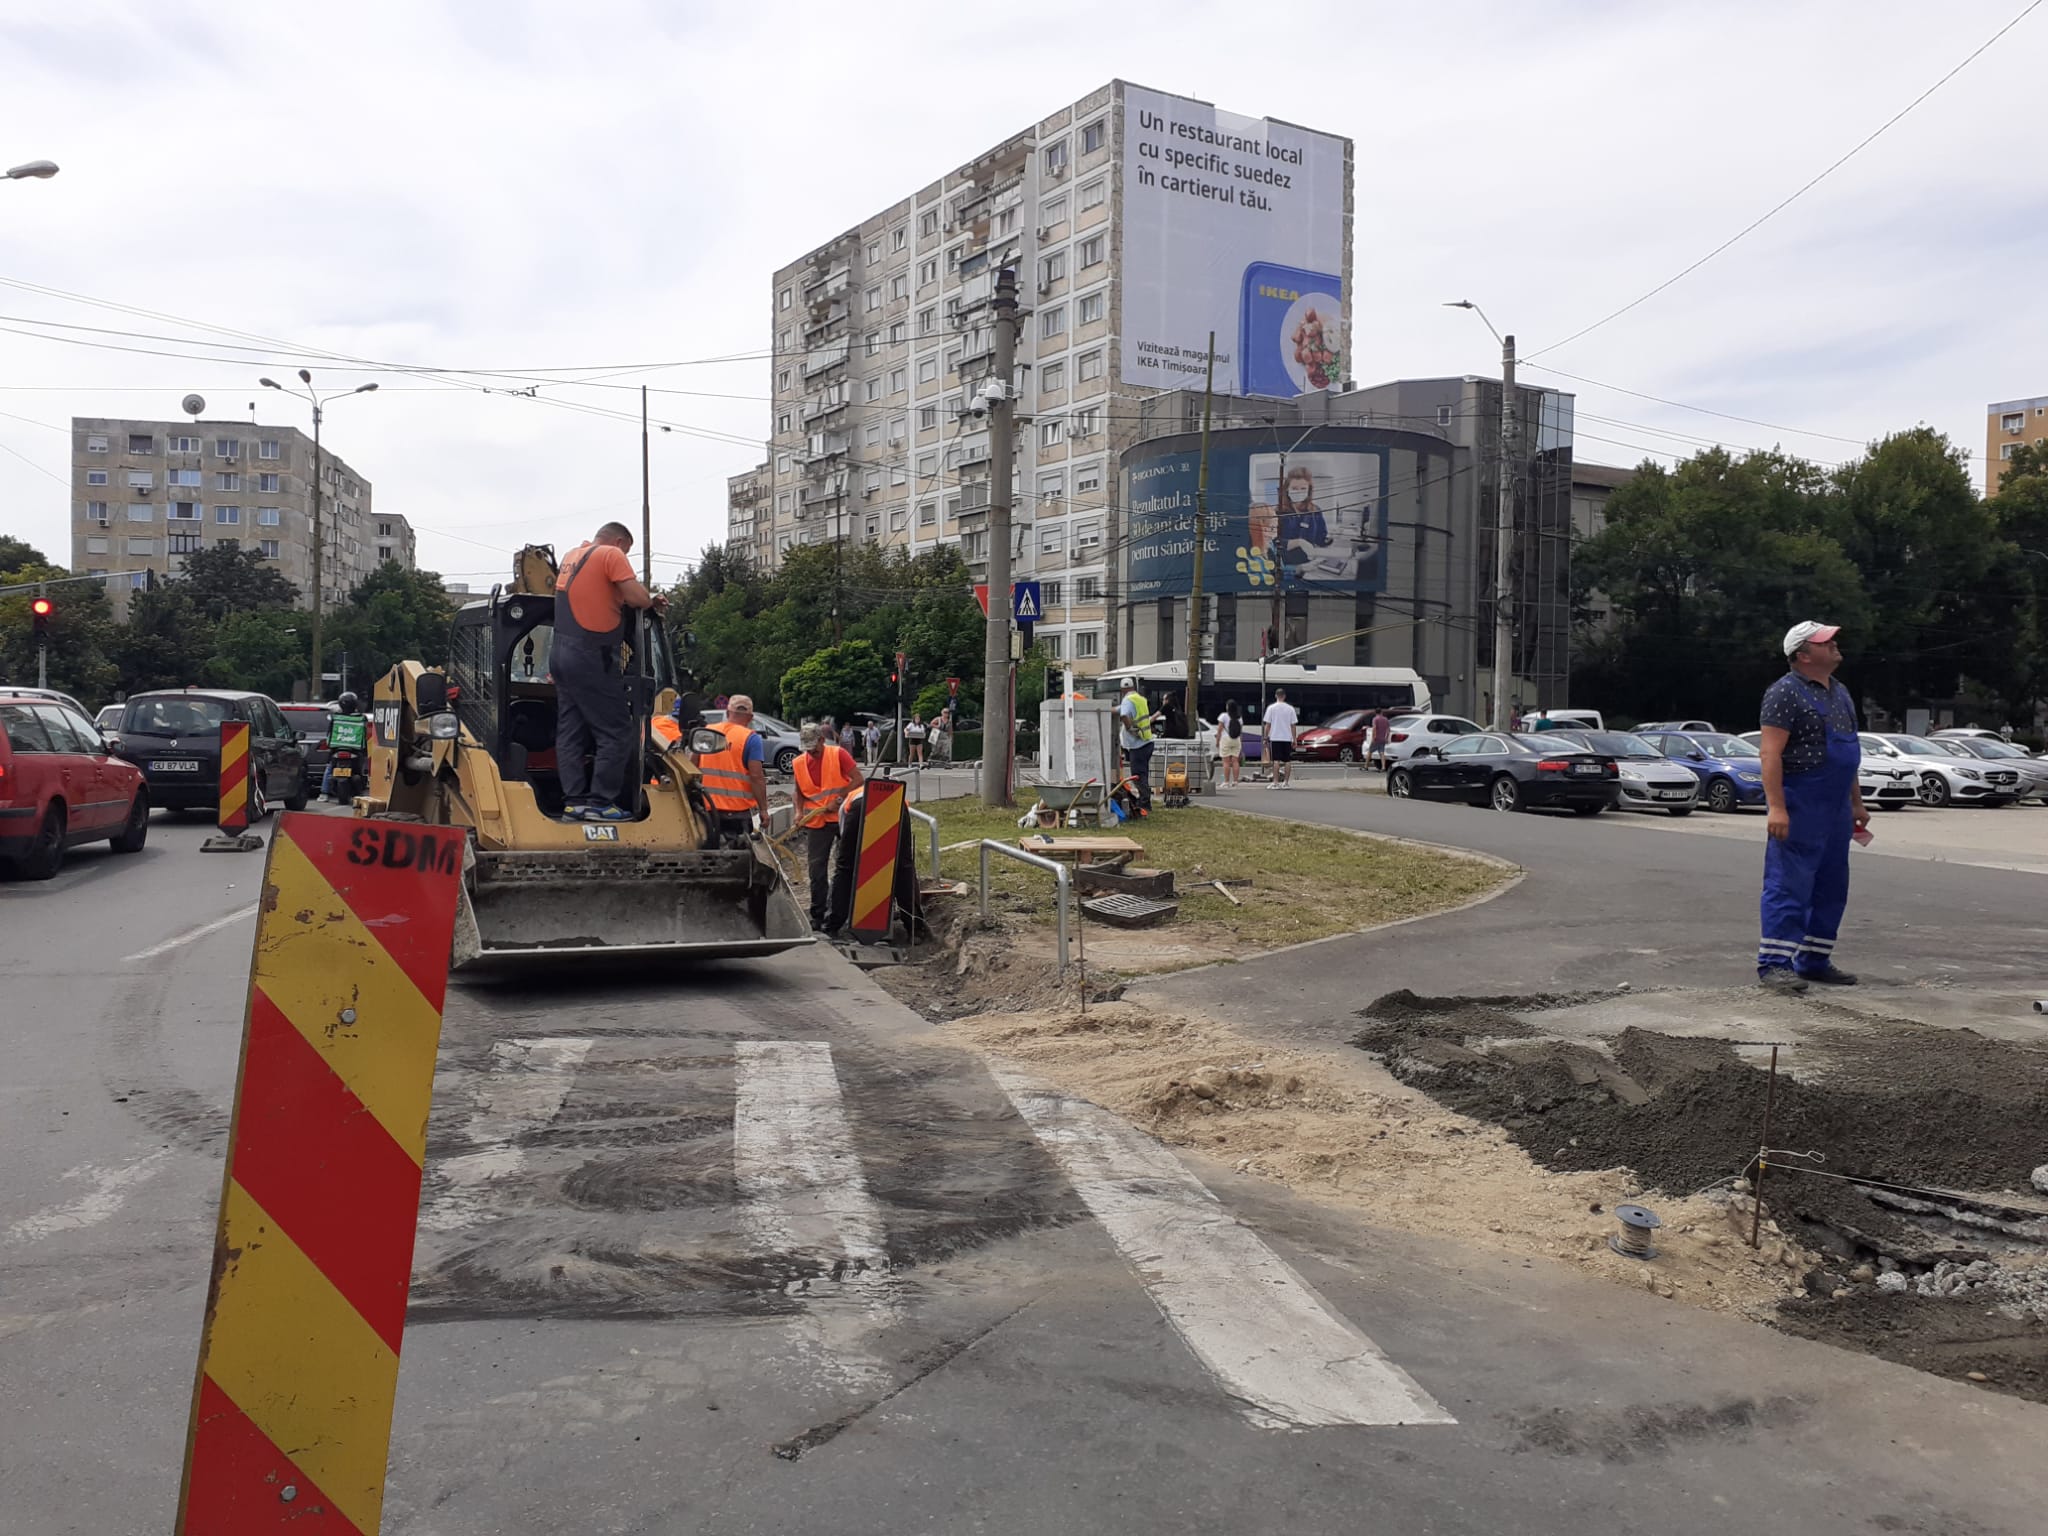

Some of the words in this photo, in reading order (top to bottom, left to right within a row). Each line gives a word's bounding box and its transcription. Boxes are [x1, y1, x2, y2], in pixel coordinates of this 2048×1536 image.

[1140, 110, 1163, 132] Un
[1170, 120, 1260, 155] restaurant
[1266, 140, 1302, 165] local
[1139, 142, 1158, 159] cu
[1165, 148, 1229, 175] specific
[1234, 165, 1291, 189] suedez
[1138, 164, 1154, 186] în
[1161, 175, 1234, 203] cartierul
[1240, 189, 1272, 212] tău.
[1259, 285, 1299, 300] IKEA
[1137, 341, 1179, 357] Vizitează
[1183, 349, 1230, 363] magainul
[1137, 356, 1159, 369] IKEA
[1162, 359, 1208, 375] Timișoara
[1182, 494, 1191, 506] a
[1131, 545, 1158, 566] pentru
[384, 707, 399, 740] CAT
[586, 826, 615, 840] CAT
[347, 827, 458, 875] SDM
